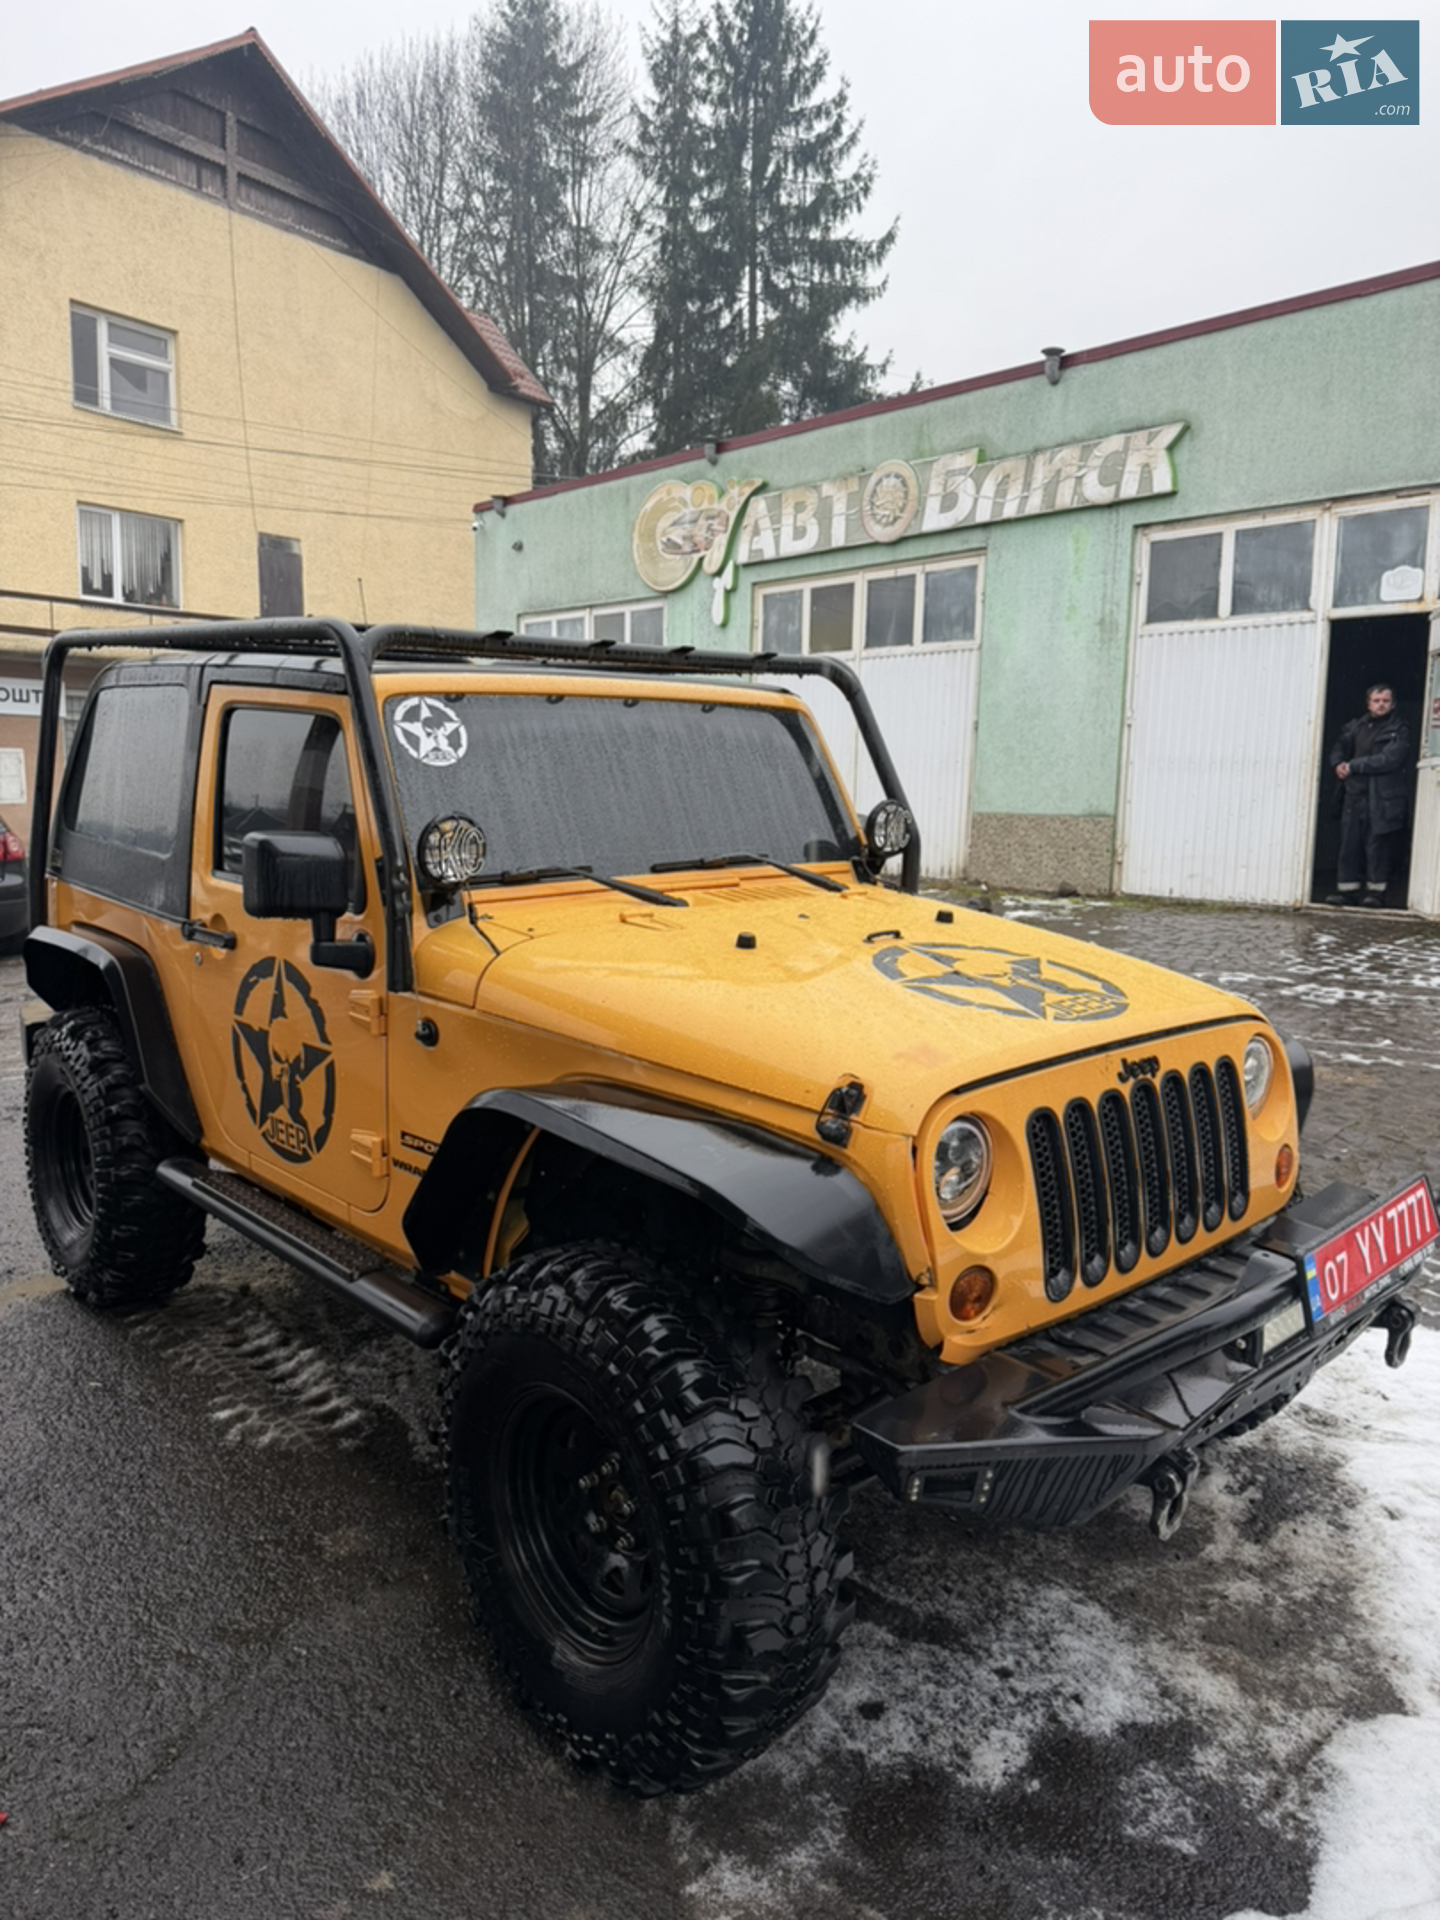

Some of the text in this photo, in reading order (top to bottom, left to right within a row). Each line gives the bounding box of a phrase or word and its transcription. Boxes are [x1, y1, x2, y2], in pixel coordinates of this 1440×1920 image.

[1117, 1055, 1161, 1083] Jeep
[265, 1116, 308, 1152] JEEP
[1323, 1250, 1348, 1301] 07
